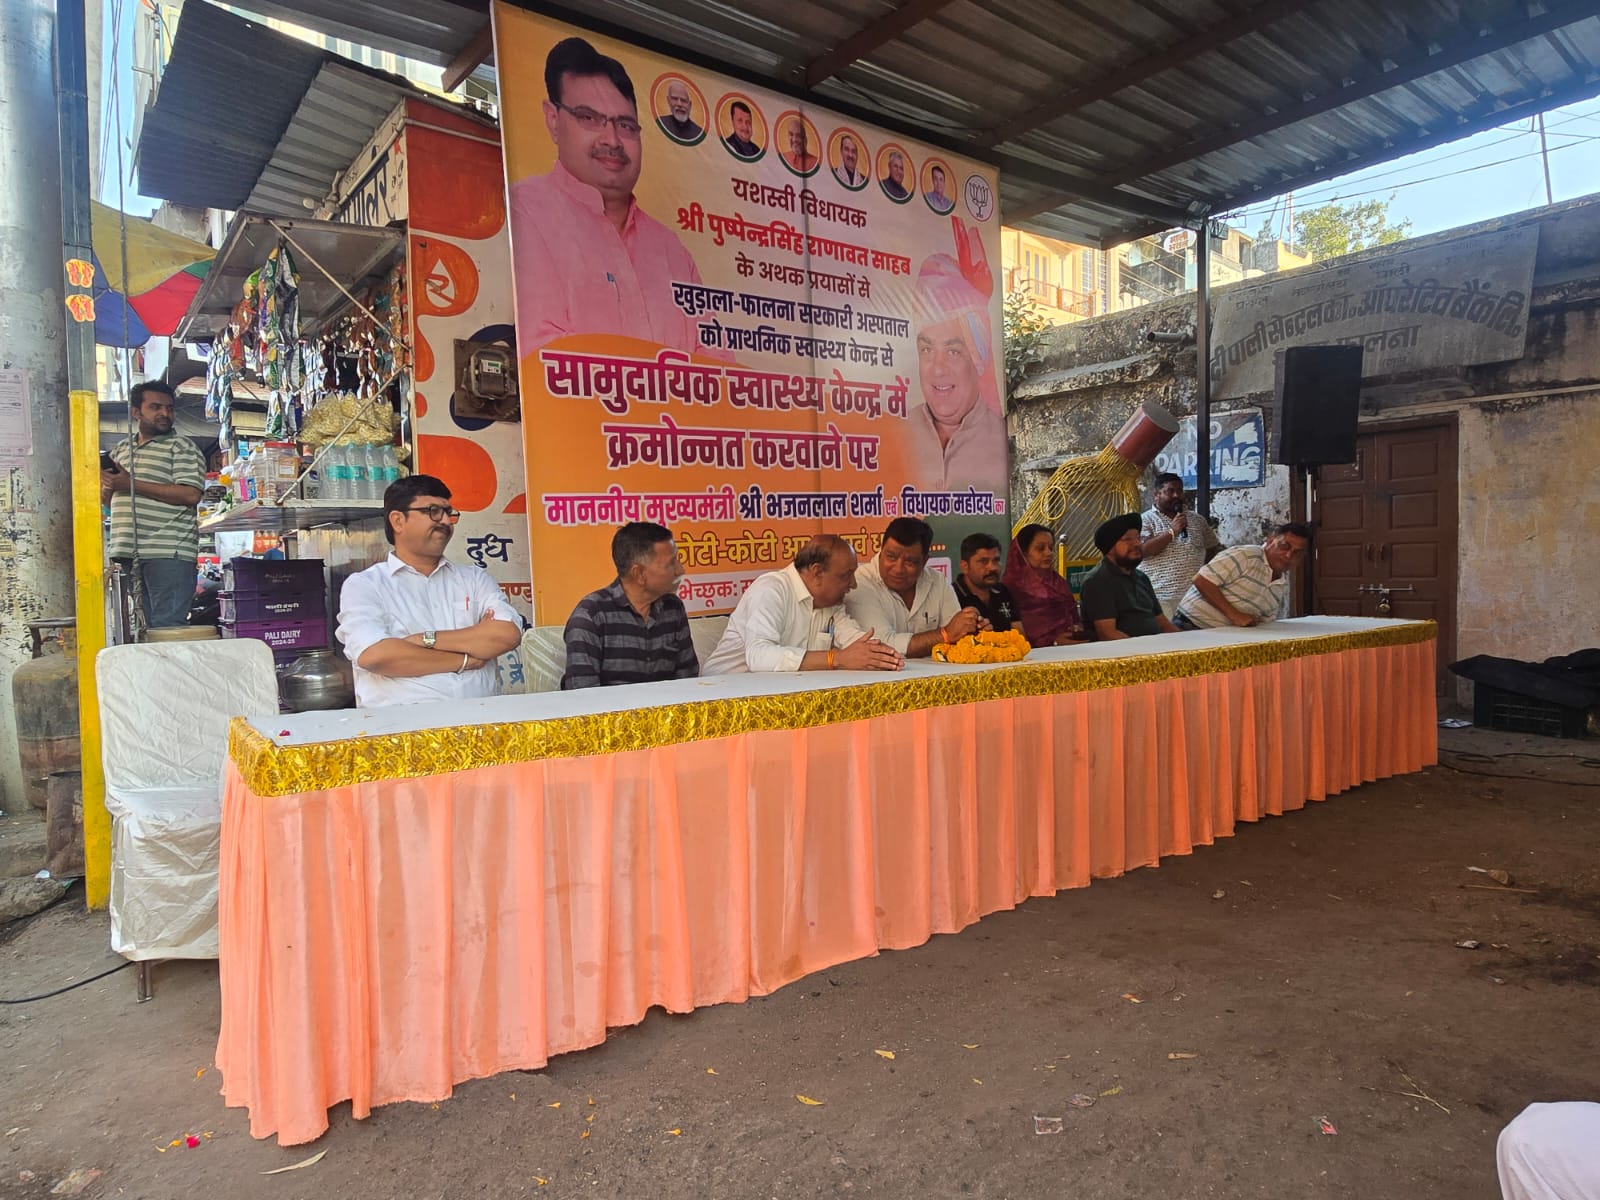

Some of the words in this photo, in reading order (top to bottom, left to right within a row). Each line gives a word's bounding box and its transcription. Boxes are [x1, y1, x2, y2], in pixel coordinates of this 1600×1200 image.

[731, 178, 796, 213] यशस्वी
[800, 190, 867, 229] विधायक
[676, 202, 704, 233] श्री
[707, 212, 804, 255] पुष्पेन्द्रसिंह
[807, 234, 869, 268] राणावत
[871, 249, 912, 276] साहब
[735, 252, 754, 278] के
[758, 261, 805, 287] अथक
[807, 271, 856, 297] प्रयासों
[857, 275, 871, 299] से
[672, 283, 796, 321] खुड़ाला-फालना
[798, 302, 853, 331] सरकारी
[856, 311, 910, 339] अस्पताल
[699, 319, 722, 348] को
[726, 325, 792, 356] प्राथमिक
[794, 335, 847, 362] स्वास्थ्य
[848, 339, 879, 367] केन्द्र
[880, 343, 894, 367] से
[1228, 320, 1268, 366] पाली
[541, 350, 722, 414] सामुदायिक
[725, 368, 826, 413] स्वास्थ्य
[829, 368, 883, 418] केन्द्र
[885, 375, 911, 418] में
[603, 414, 746, 468] क्रमोन्नत
[749, 423, 843, 470] करवाने
[845, 436, 879, 470] पर
[1187, 420, 1223, 441] NO
[544, 486, 642, 524] माननीय
[643, 486, 735, 527] मुख्यमंत्री
[738, 486, 763, 519] श्री
[766, 492, 848, 518] भजनलाल
[850, 486, 883, 516] शर्मा
[884, 498, 897, 516] एवं
[902, 487, 951, 516] विधायक
[952, 486, 993, 515] महोदय
[994, 499, 1004, 514] का
[678, 579, 738, 608] भेच्छूक:
[265, 631, 280, 640] PALI
[281, 629, 301, 640] DAIRY
